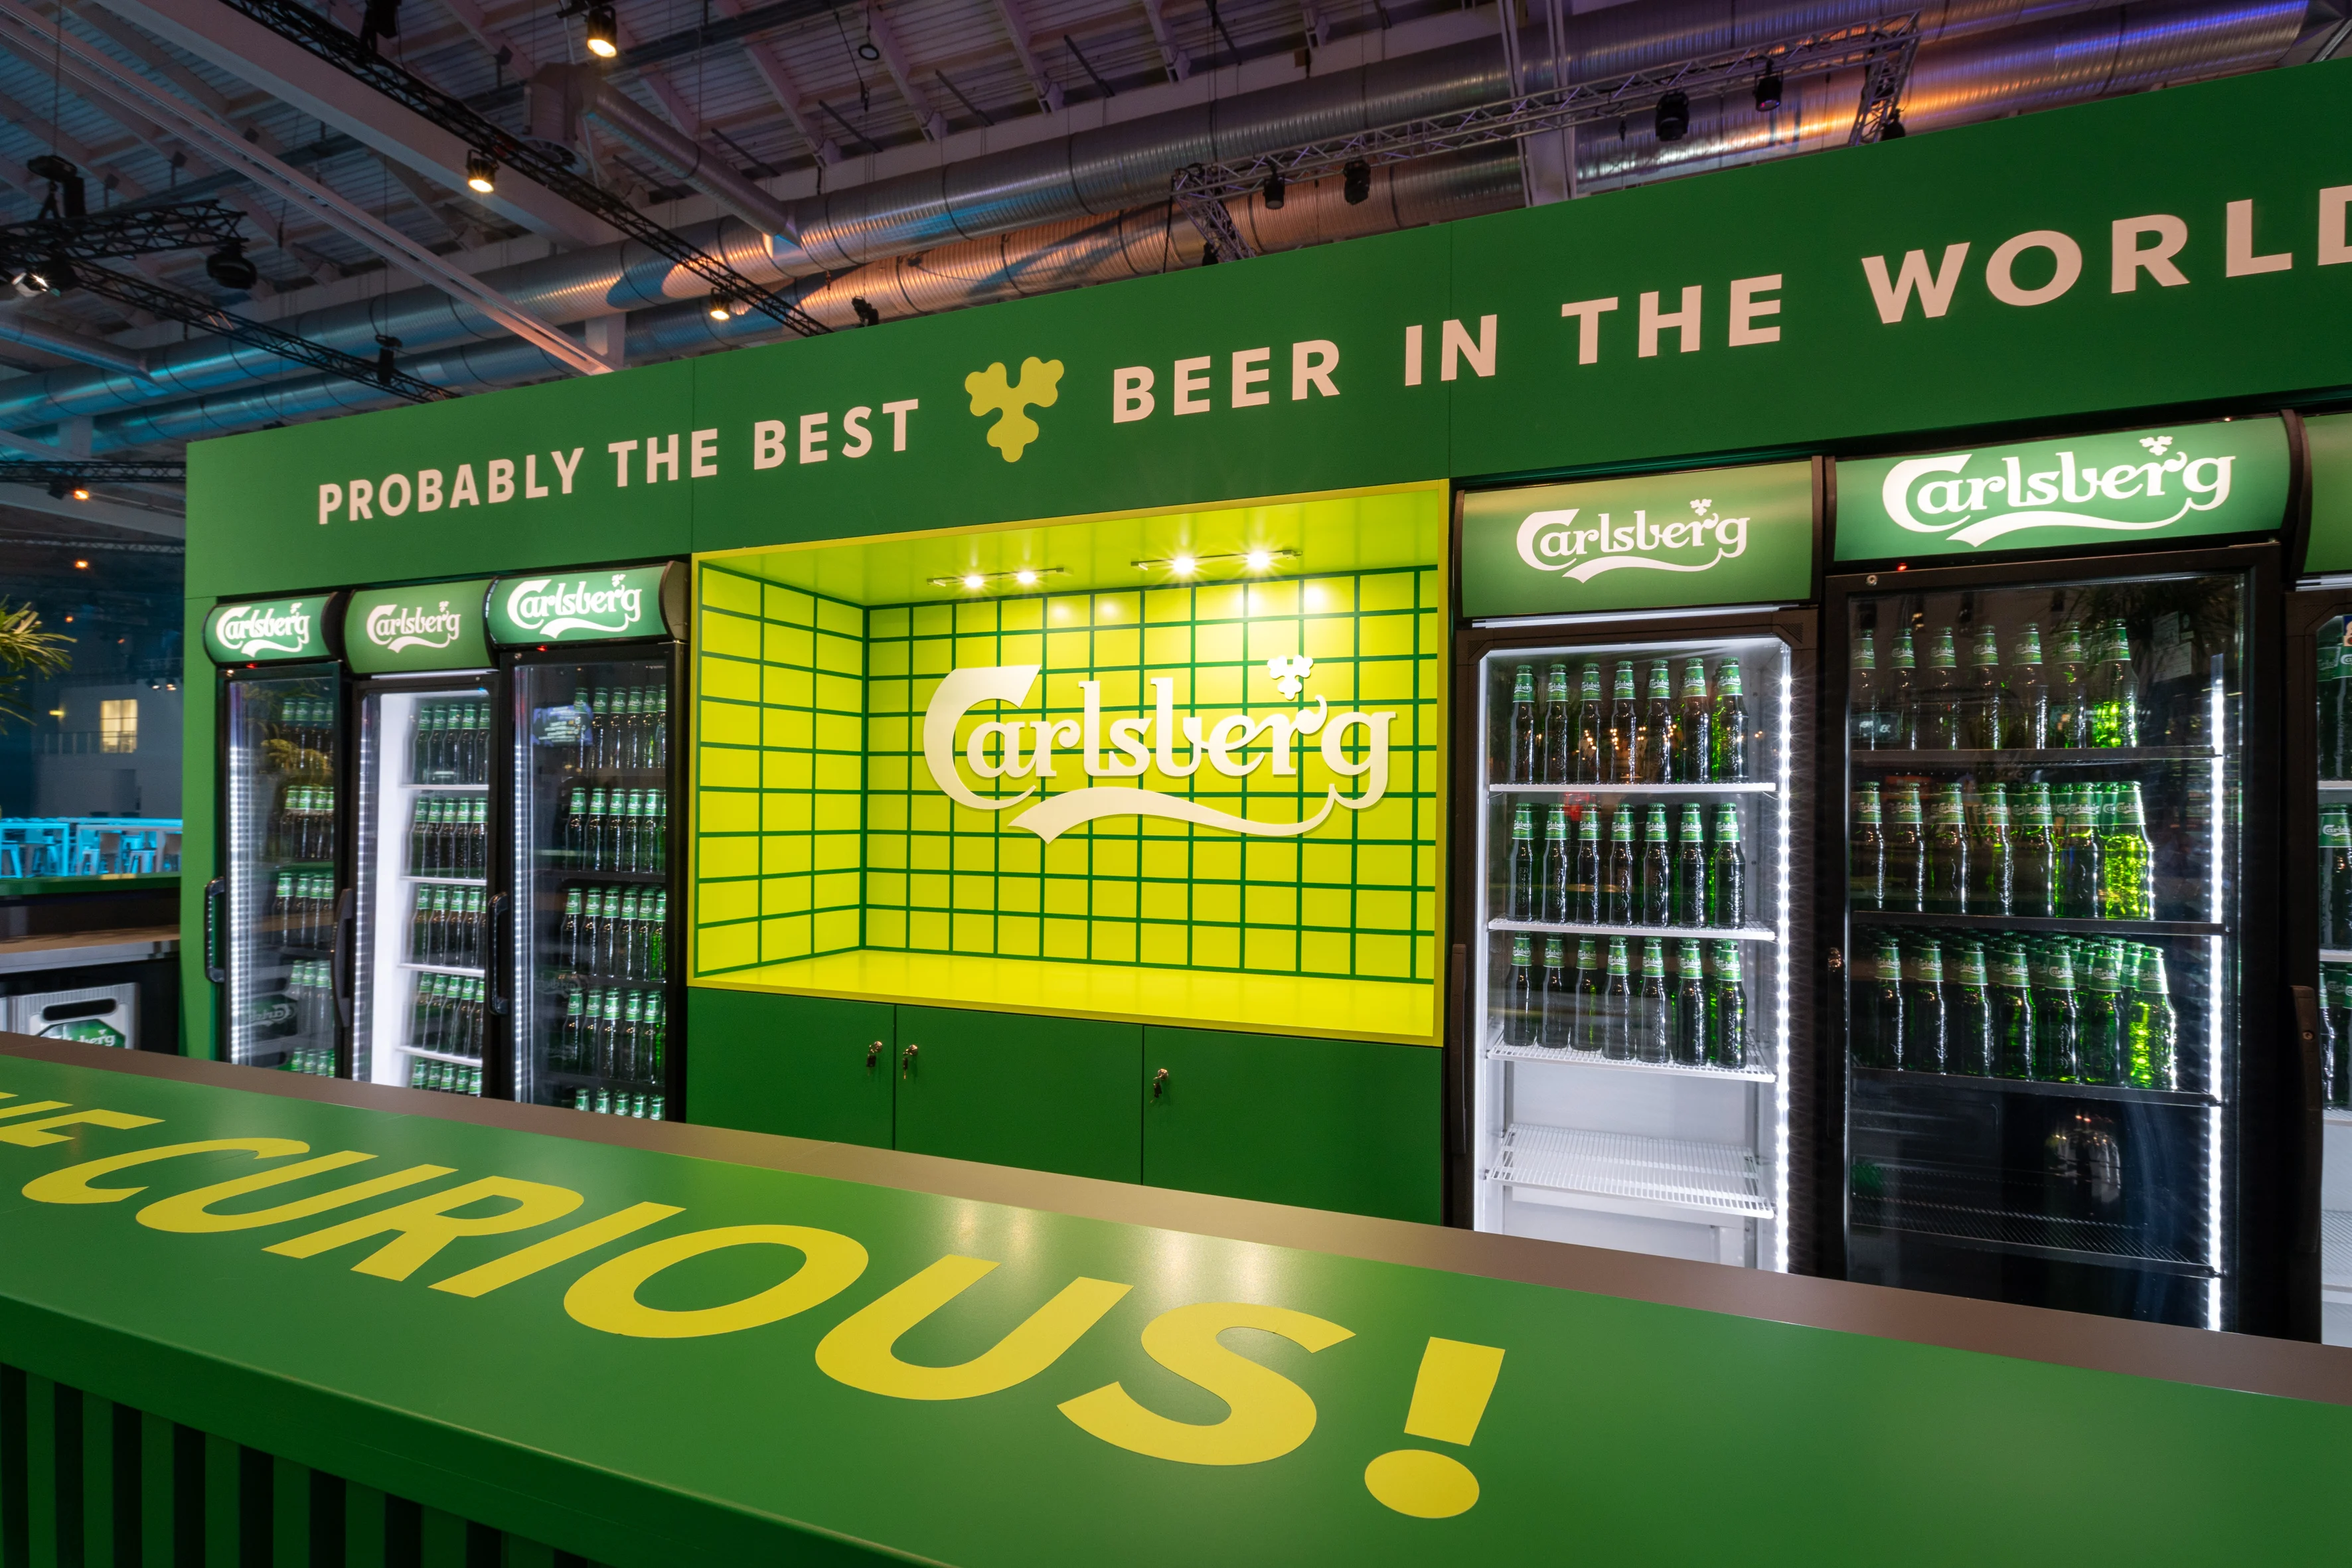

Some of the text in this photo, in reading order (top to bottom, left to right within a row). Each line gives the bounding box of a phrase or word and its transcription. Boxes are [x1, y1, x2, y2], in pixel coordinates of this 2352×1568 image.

[319, 447, 584, 524] PROBABLY
[608, 428, 718, 487] THE
[753, 399, 918, 469] BEST
[1113, 339, 1340, 424] BEER
[1404, 314, 1497, 386] IN
[1561, 274, 1782, 365] THE
[1882, 451, 2236, 547] Carlsberg
[1516, 506, 1750, 584] Carlsberg
[216, 604, 311, 657] Carlsberg
[366, 603, 461, 653] Carlsberg
[507, 577, 642, 639] Carlsberg
[923, 664, 1397, 844] Carlsberg
[22, 1138, 1506, 1519] CURIOUS!
